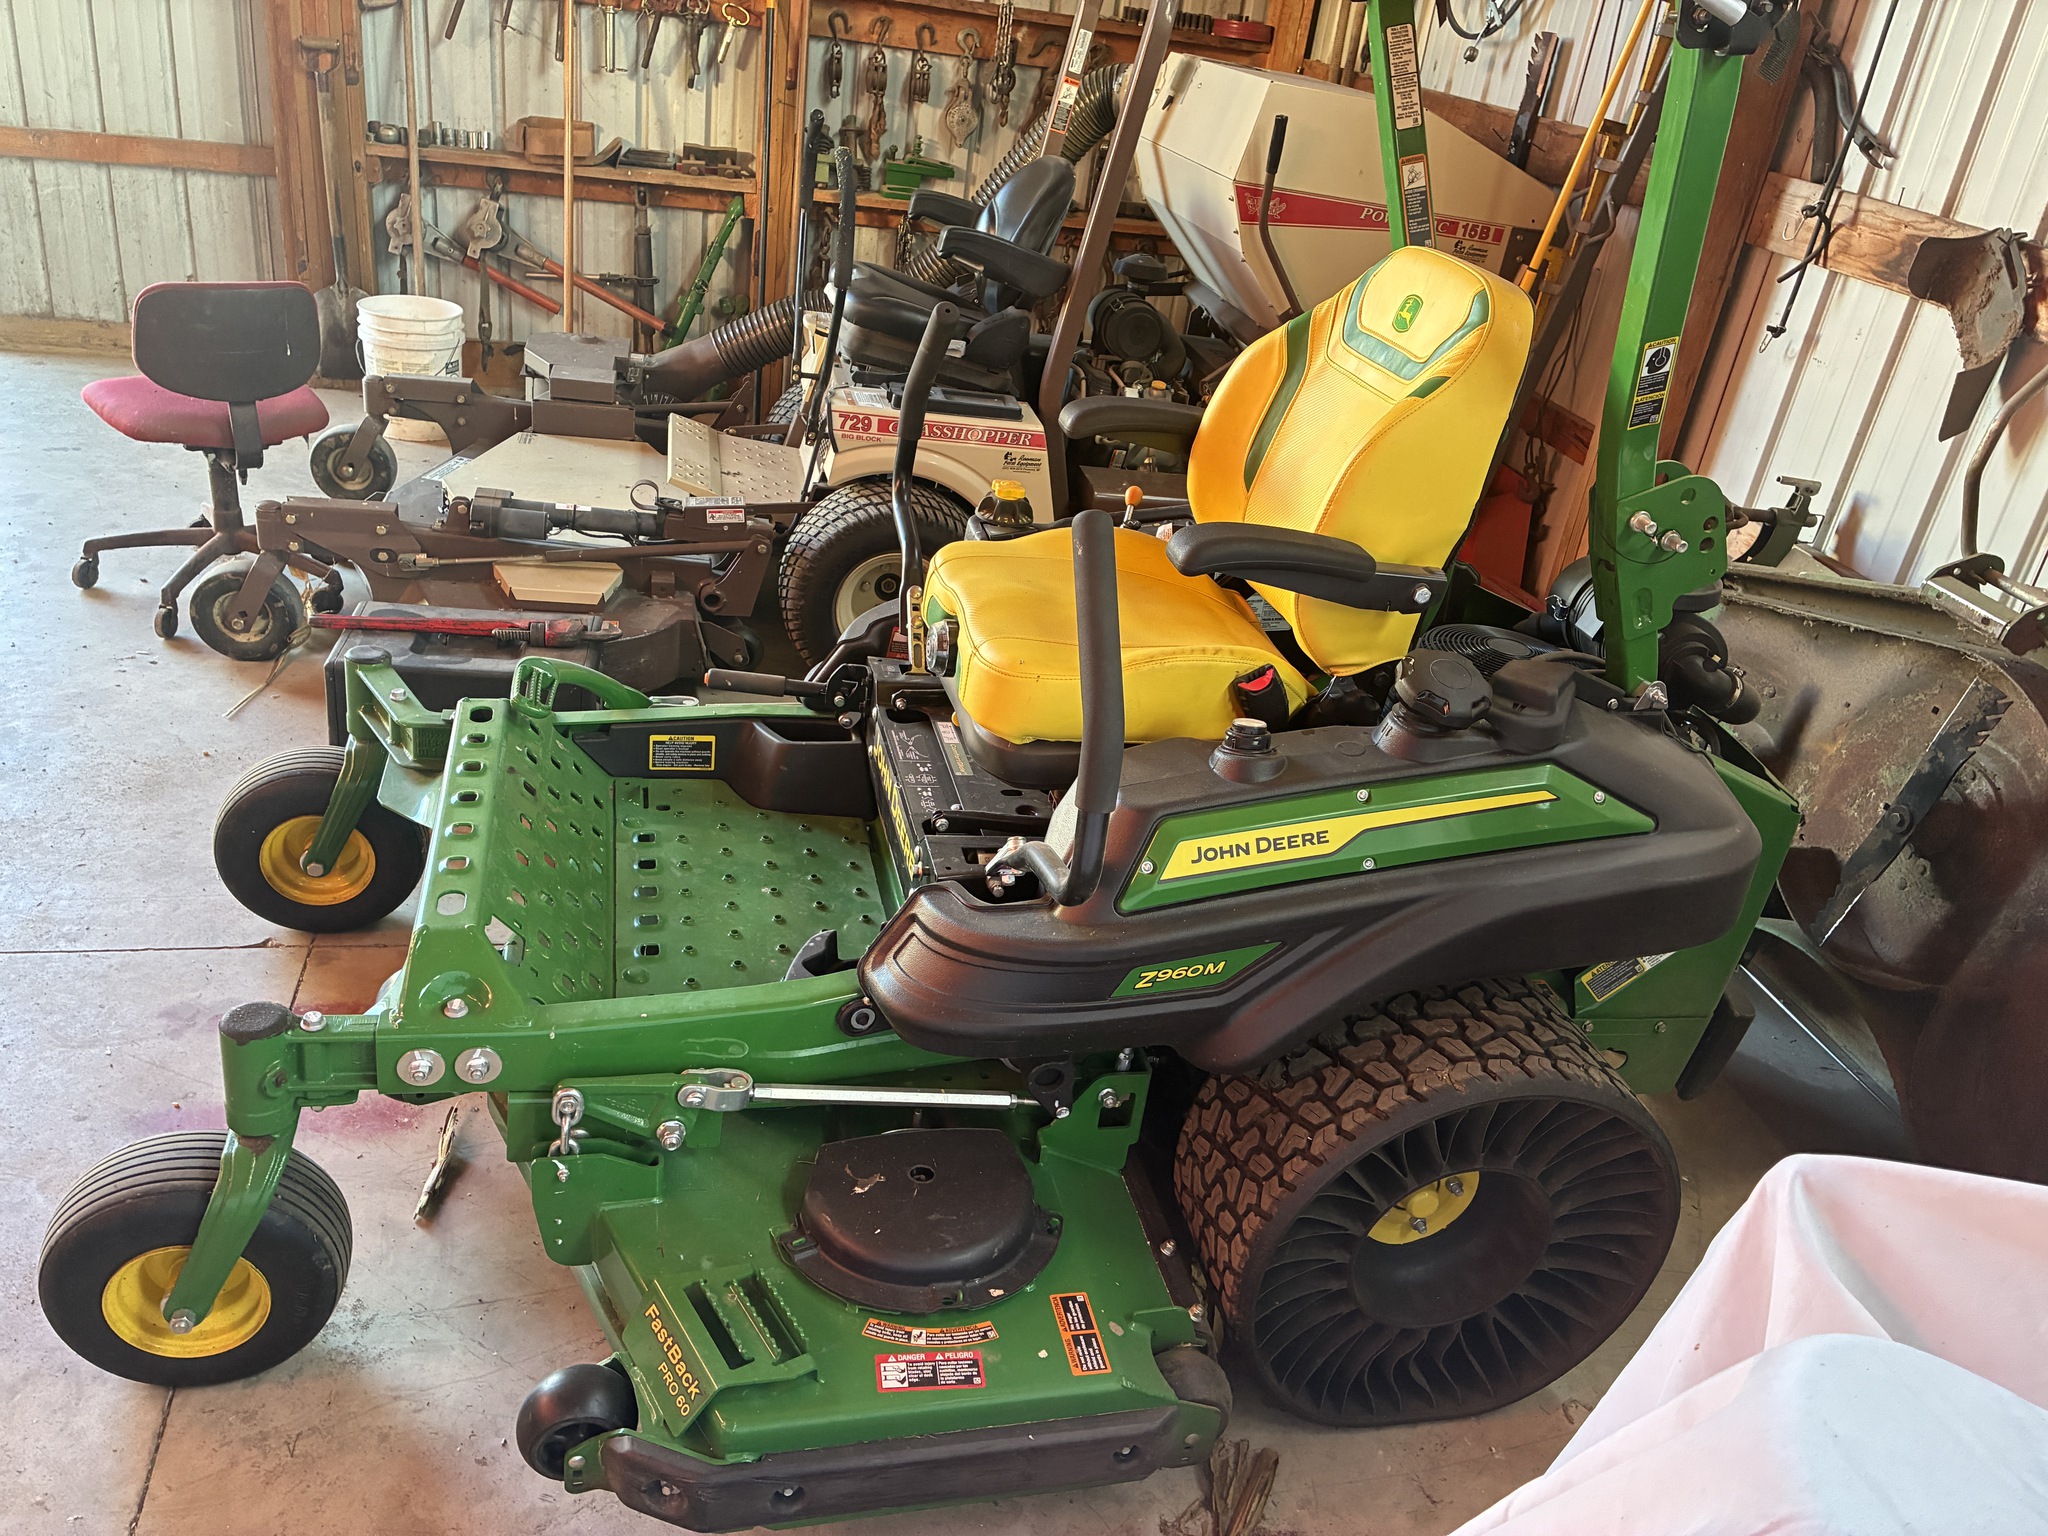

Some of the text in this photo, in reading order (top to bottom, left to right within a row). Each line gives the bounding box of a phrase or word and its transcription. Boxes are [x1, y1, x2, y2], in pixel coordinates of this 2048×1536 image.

[1461, 223, 1491, 241] 15B
[1652, 338, 1677, 348] CAUTION
[838, 413, 1032, 446] 729 GASSHOPPER
[856, 434, 882, 443] BLOCK
[891, 786, 915, 881] DEERE
[1191, 830, 1330, 864] JOHN DEERE
[1134, 960, 1227, 990] Z960M
[1052, 1296, 1066, 1327] ADVERTENCIA
[645, 1303, 701, 1401] FastBack
[897, 1353, 926, 1361] DANGER
[944, 1351, 974, 1359] PELIGRO
[1065, 1338, 1076, 1362] WARNING
[658, 1361, 690, 1417] PRO 60
